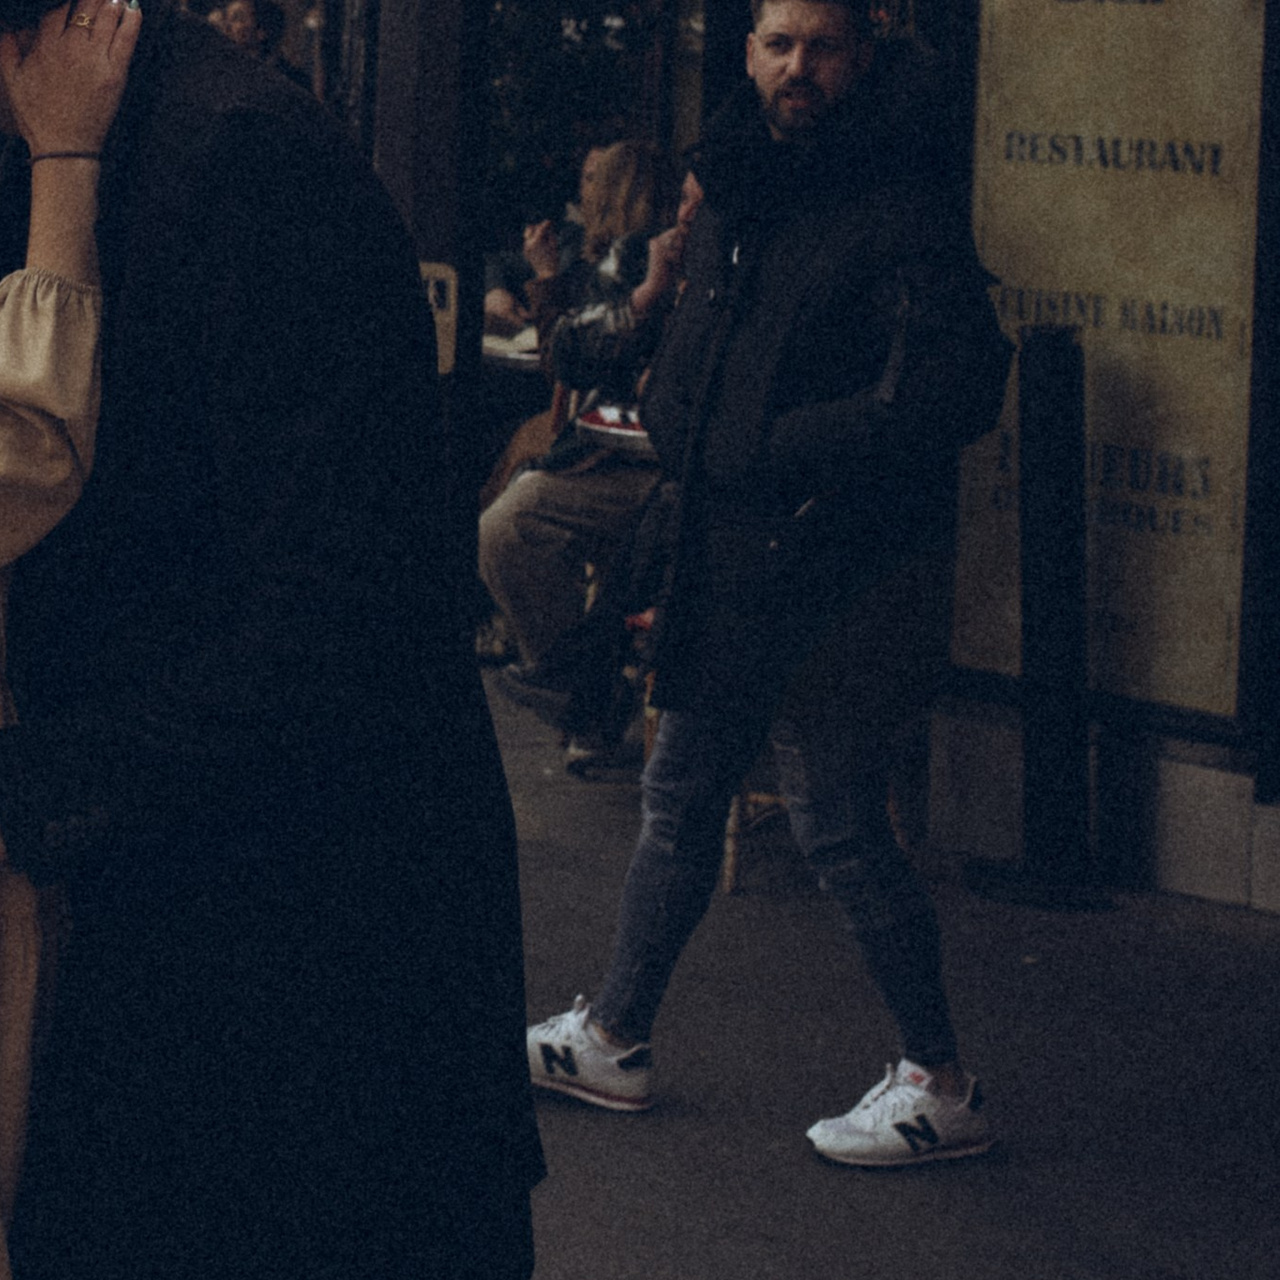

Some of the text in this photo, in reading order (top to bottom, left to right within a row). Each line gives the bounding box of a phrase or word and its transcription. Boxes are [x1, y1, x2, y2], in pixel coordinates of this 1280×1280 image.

[1005, 130, 1222, 176] RESTAURANT
[539, 1042, 579, 1076] N
[893, 1113, 939, 1152] N
